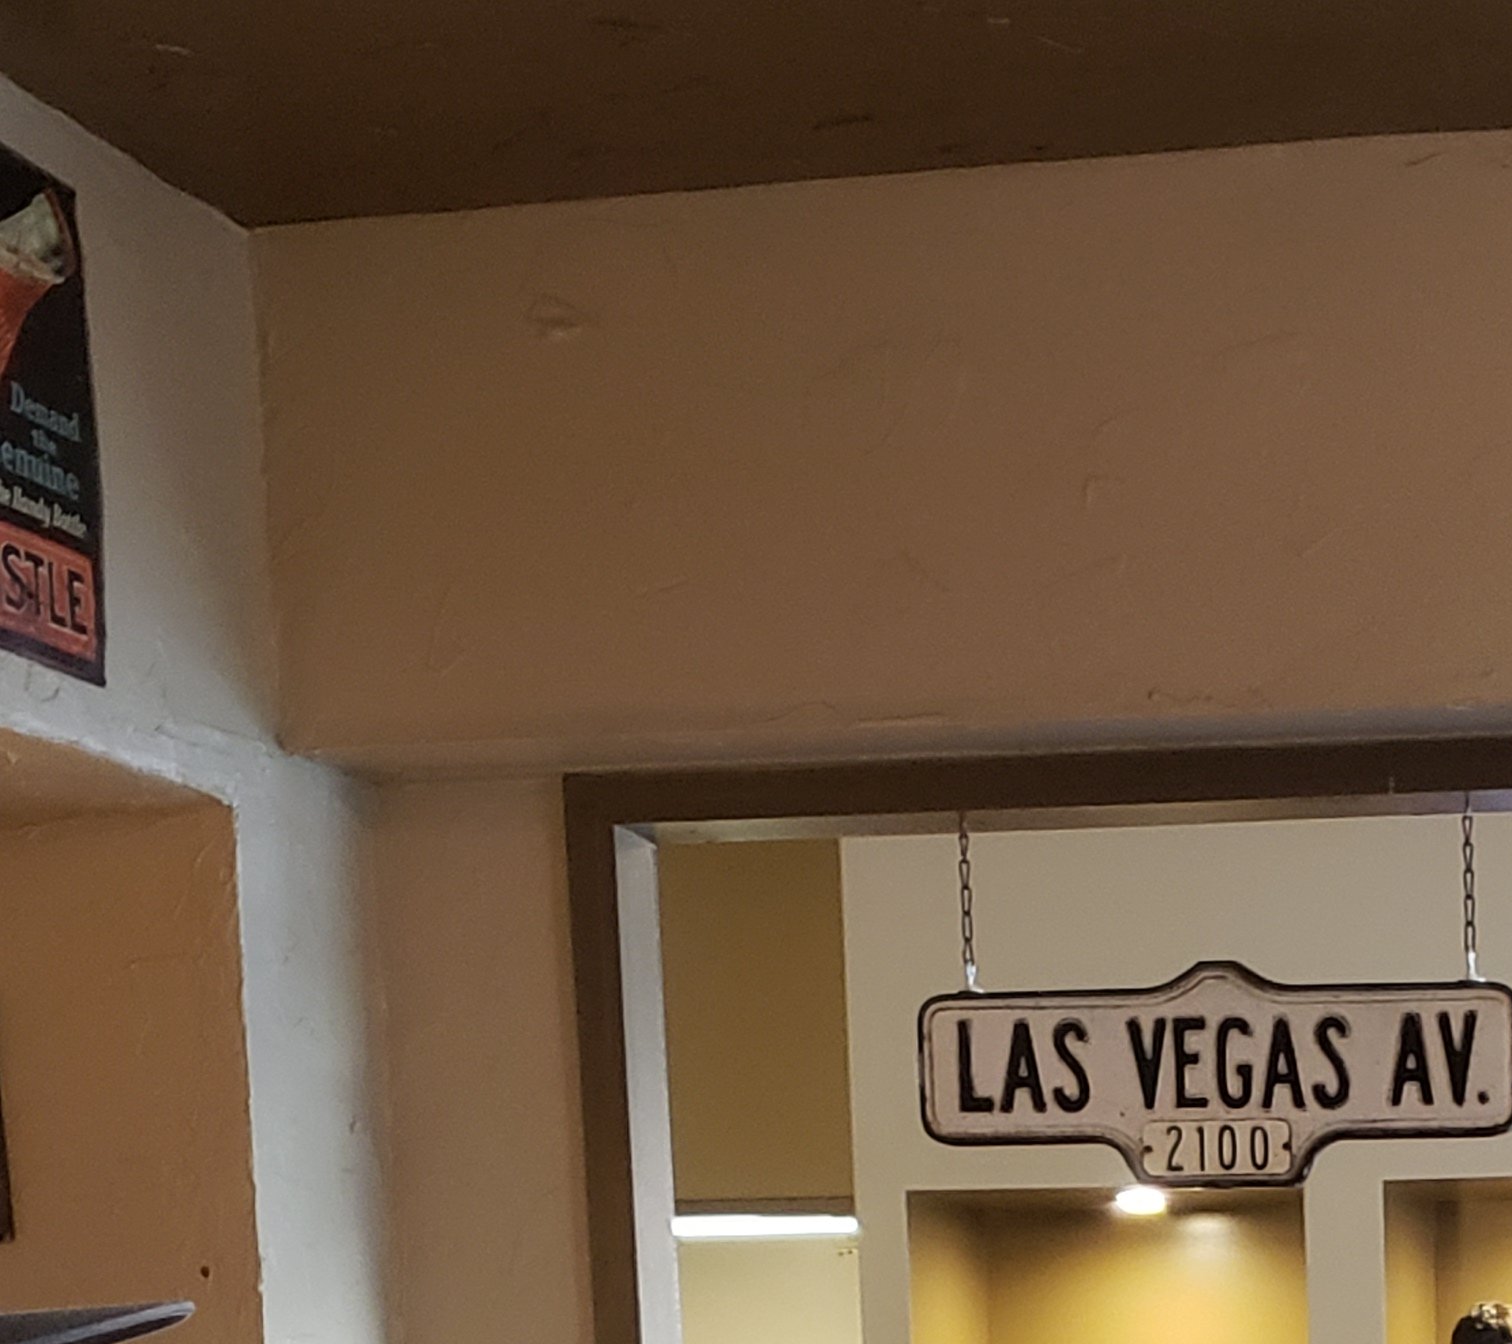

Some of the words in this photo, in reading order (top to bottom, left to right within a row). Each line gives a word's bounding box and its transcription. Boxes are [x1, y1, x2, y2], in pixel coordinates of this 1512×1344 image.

[10, 380, 82, 443] Demand
[956, 1017, 1092, 1115] LAS
[1125, 1014, 1352, 1112] VEGAS
[1387, 1008, 1492, 1109] AV.
[1165, 1123, 1272, 1173] 2100
